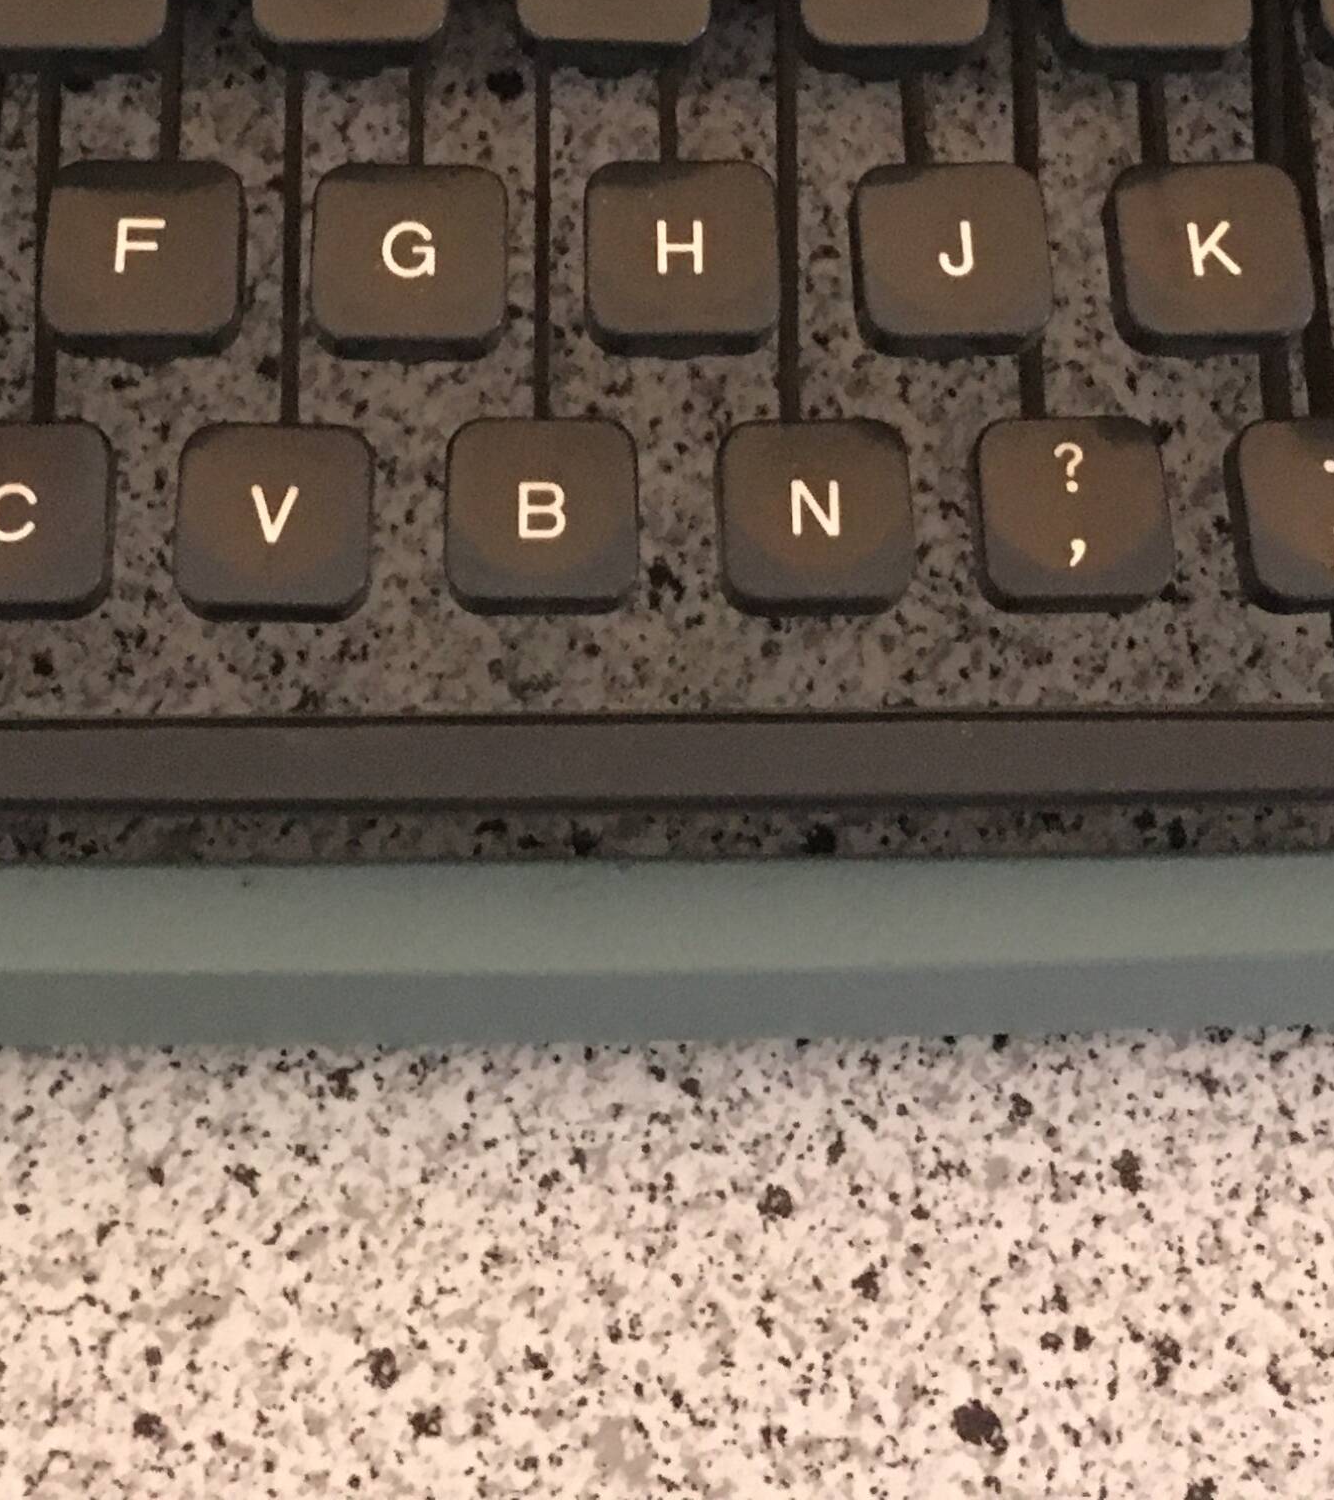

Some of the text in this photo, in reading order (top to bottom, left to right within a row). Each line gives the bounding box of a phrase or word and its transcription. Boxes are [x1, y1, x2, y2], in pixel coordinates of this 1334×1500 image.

[112, 216, 168, 276] F
[379, 219, 438, 280] G
[654, 217, 705, 277] H
[936, 218, 976, 279] J
[1184, 218, 1244, 279] K
[1051, 440, 1086, 495] ?
[249, 482, 301, 546] V
[516, 479, 568, 541] B
[788, 477, 842, 539] N
[1067, 536, 1088, 569] ,
